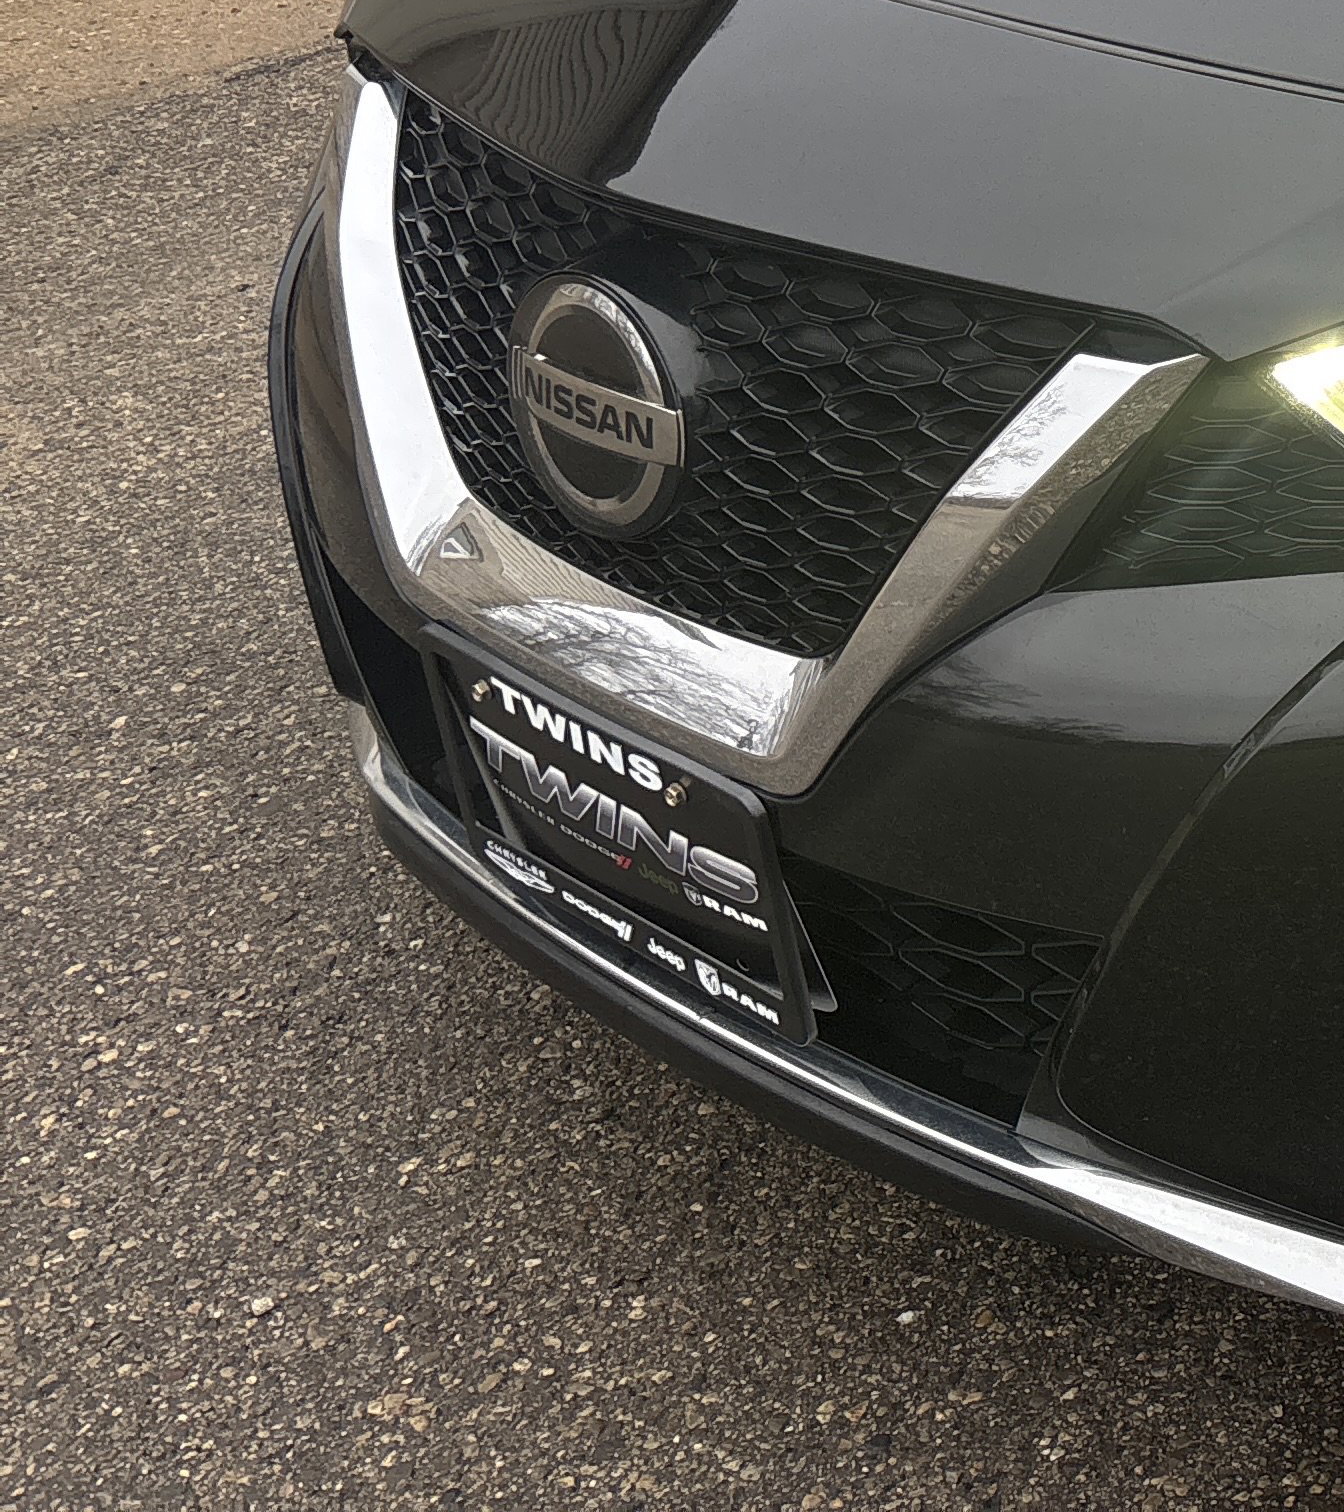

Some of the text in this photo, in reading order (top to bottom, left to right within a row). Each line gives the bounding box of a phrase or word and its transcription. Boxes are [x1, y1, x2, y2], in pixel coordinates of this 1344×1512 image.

[524, 365, 654, 450] NISSAN
[490, 676, 663, 792] TWINS
[469, 715, 759, 905] TWINS
[486, 840, 547, 881] CHRYSLER
[648, 937, 686, 971] Jeep
[720, 981, 780, 1026] RAM
[702, 894, 769, 932] RAM
